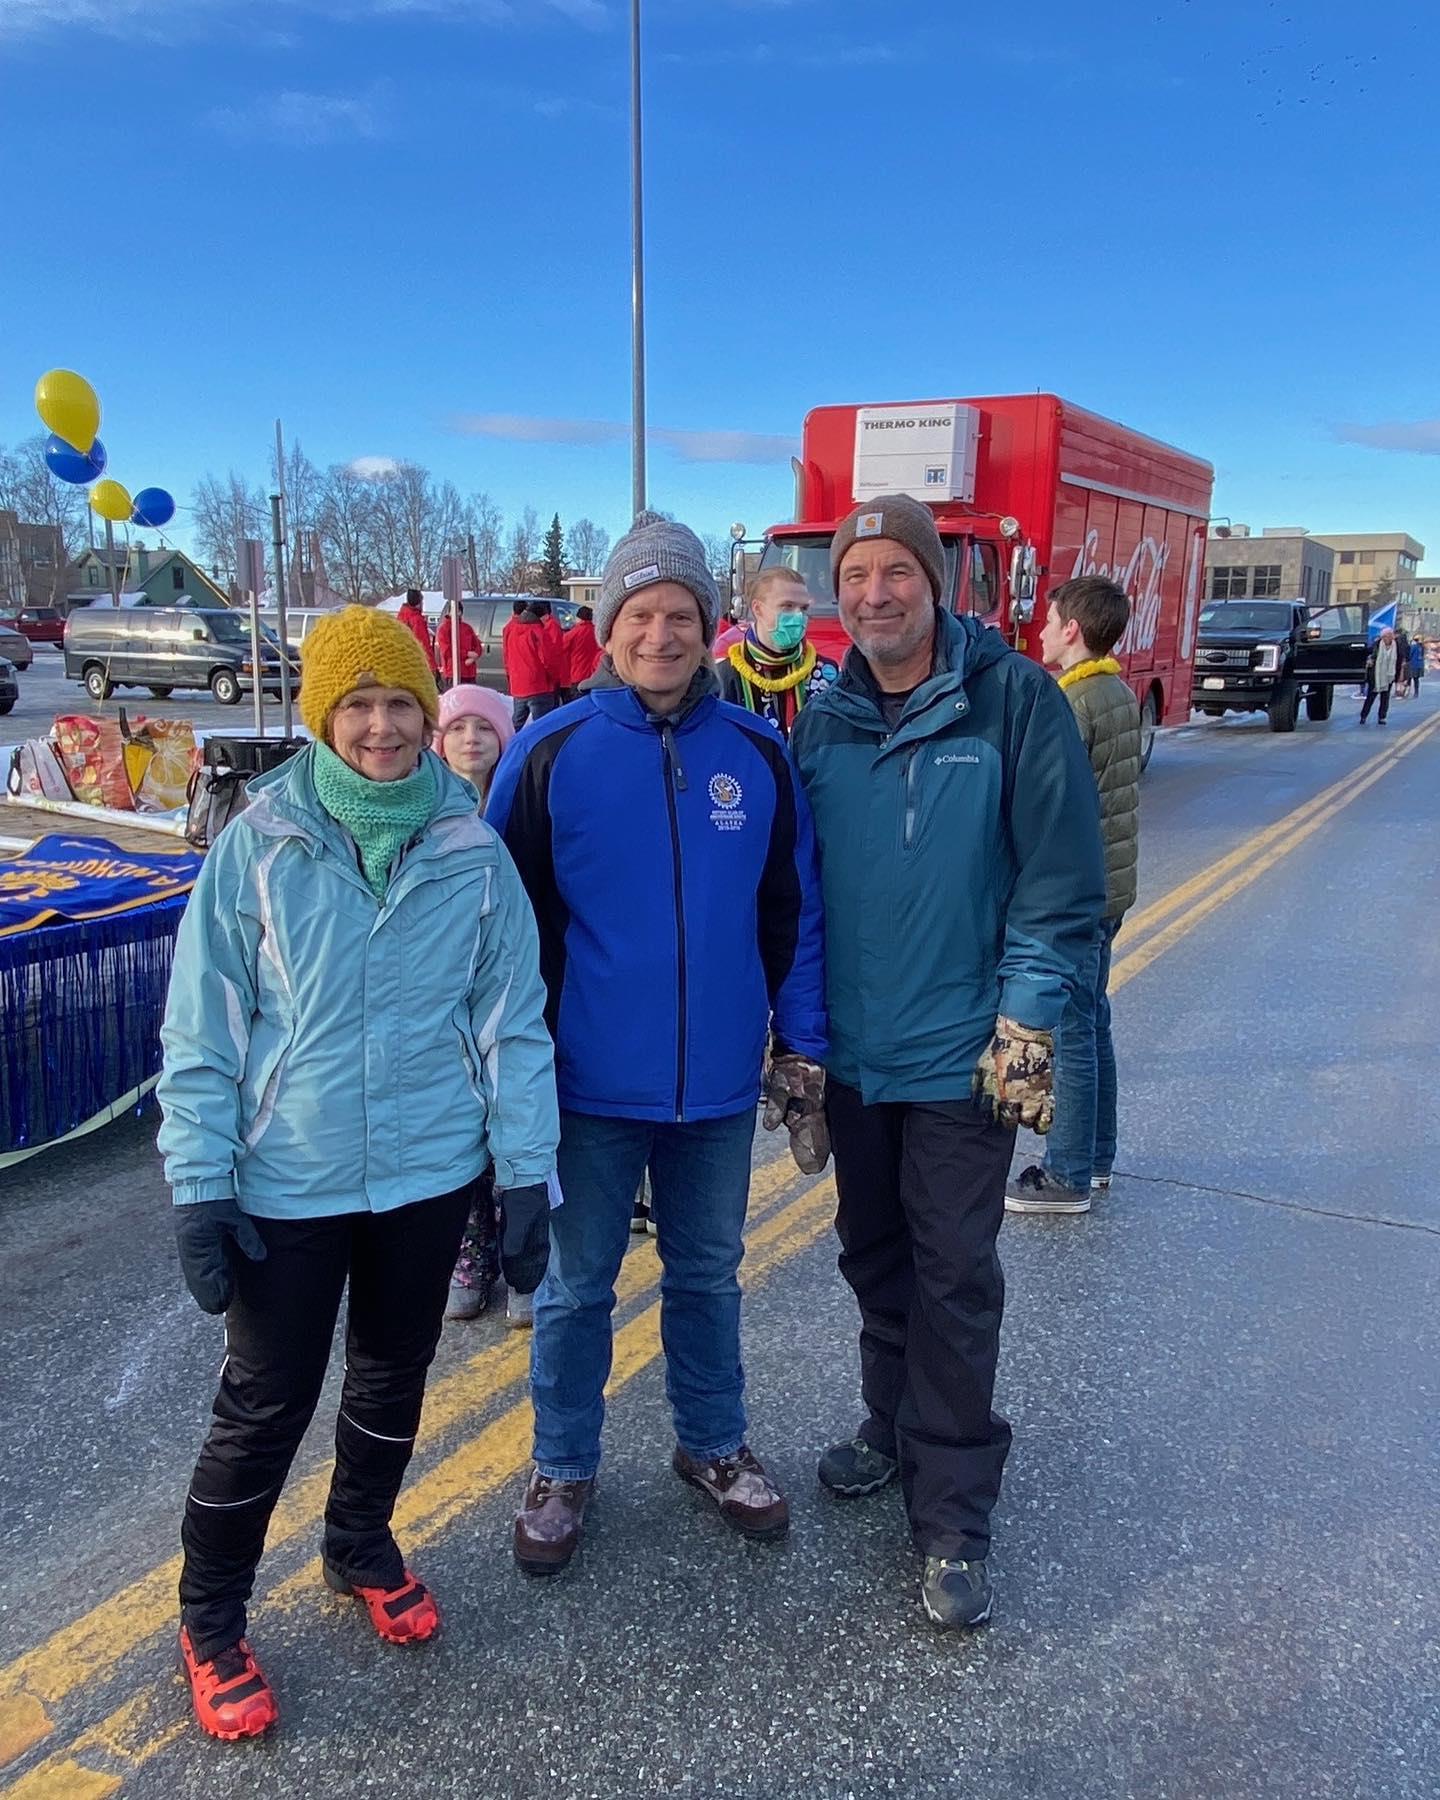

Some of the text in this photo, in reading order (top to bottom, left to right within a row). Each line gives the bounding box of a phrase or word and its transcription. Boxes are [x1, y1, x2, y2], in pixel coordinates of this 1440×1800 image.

[864, 418, 952, 430] THERMO KING
[942, 754, 979, 764] Columbia
